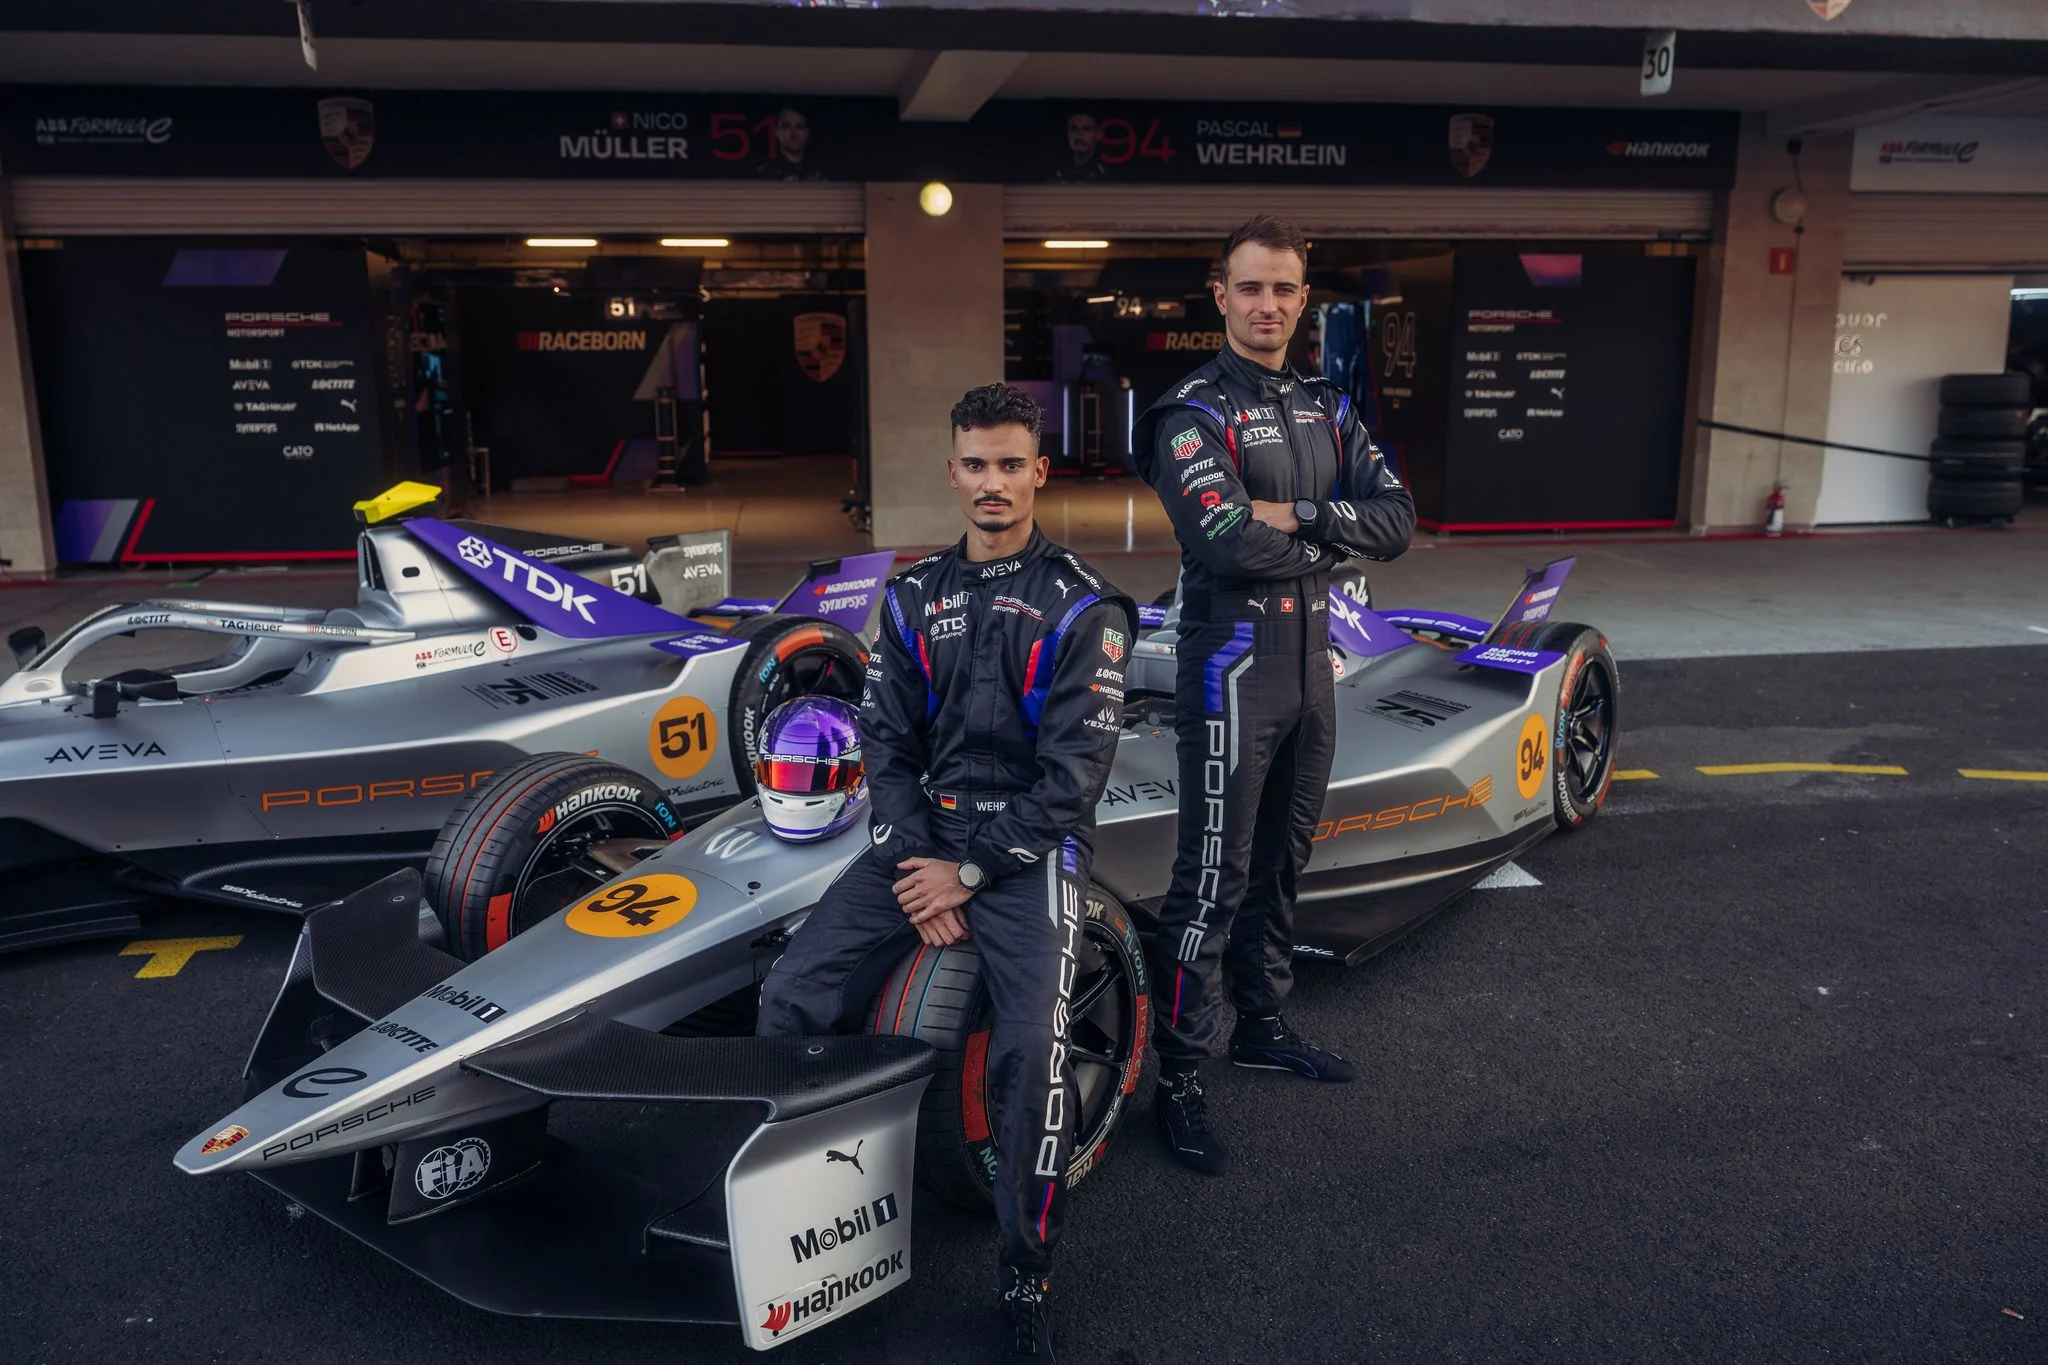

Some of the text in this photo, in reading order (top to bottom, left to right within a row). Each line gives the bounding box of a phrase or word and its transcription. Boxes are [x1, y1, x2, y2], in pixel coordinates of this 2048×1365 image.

[1644, 46, 1670, 79] 30
[632, 112, 688, 130] NICO
[1196, 120, 1273, 137] PASCAL
[560, 130, 688, 159] MÜLLER
[710, 112, 779, 160] 51
[1097, 117, 1176, 165] 94
[1196, 143, 1345, 166] WEHRLEIN
[225, 312, 330, 322] PORSCHE
[609, 297, 636, 317] 51
[1116, 296, 1142, 316] 94
[538, 330, 647, 351] RACEBORN
[1163, 331, 1222, 351] RACEB
[1381, 311, 1418, 379] 94
[232, 379, 271, 391] AVEVA
[1171, 430, 1197, 448] TAG
[1249, 426, 1282, 439] TDK
[282, 445, 314, 457] CATO
[1174, 440, 1201, 459] HEUER
[522, 542, 604, 558] PORSCHE
[609, 563, 648, 597] 51
[683, 563, 723, 580] AVEVA
[980, 560, 1022, 579] AVEVA
[492, 546, 598, 626] TDK
[924, 593, 961, 617] Mobil
[994, 595, 1042, 617] PORSCHE
[128, 613, 170, 625] LOCTITE
[314, 626, 358, 637] RACEBORN
[496, 631, 511, 647] E
[1106, 631, 1124, 645] TAG
[1486, 647, 1539, 658] RACING
[1095, 667, 1124, 683] LOCTITE
[659, 712, 708, 759] 51
[44, 741, 167, 764] AVEVA
[763, 753, 841, 767] PORSCHE
[1521, 731, 1545, 781] 94
[1103, 780, 1177, 806] AVEV
[1311, 775, 1492, 842] ORSCHE
[1177, 719, 1225, 962] PORSCHE
[587, 883, 681, 927] 94
[421, 984, 483, 1013] Mobil
[368, 1021, 440, 1053] LOCTITE
[1034, 879, 1079, 1177] PORSCHE
[263, 1086, 436, 1161] PORSCHE
[790, 1204, 872, 1264] Mobil
[793, 1250, 904, 1323] Hankook
